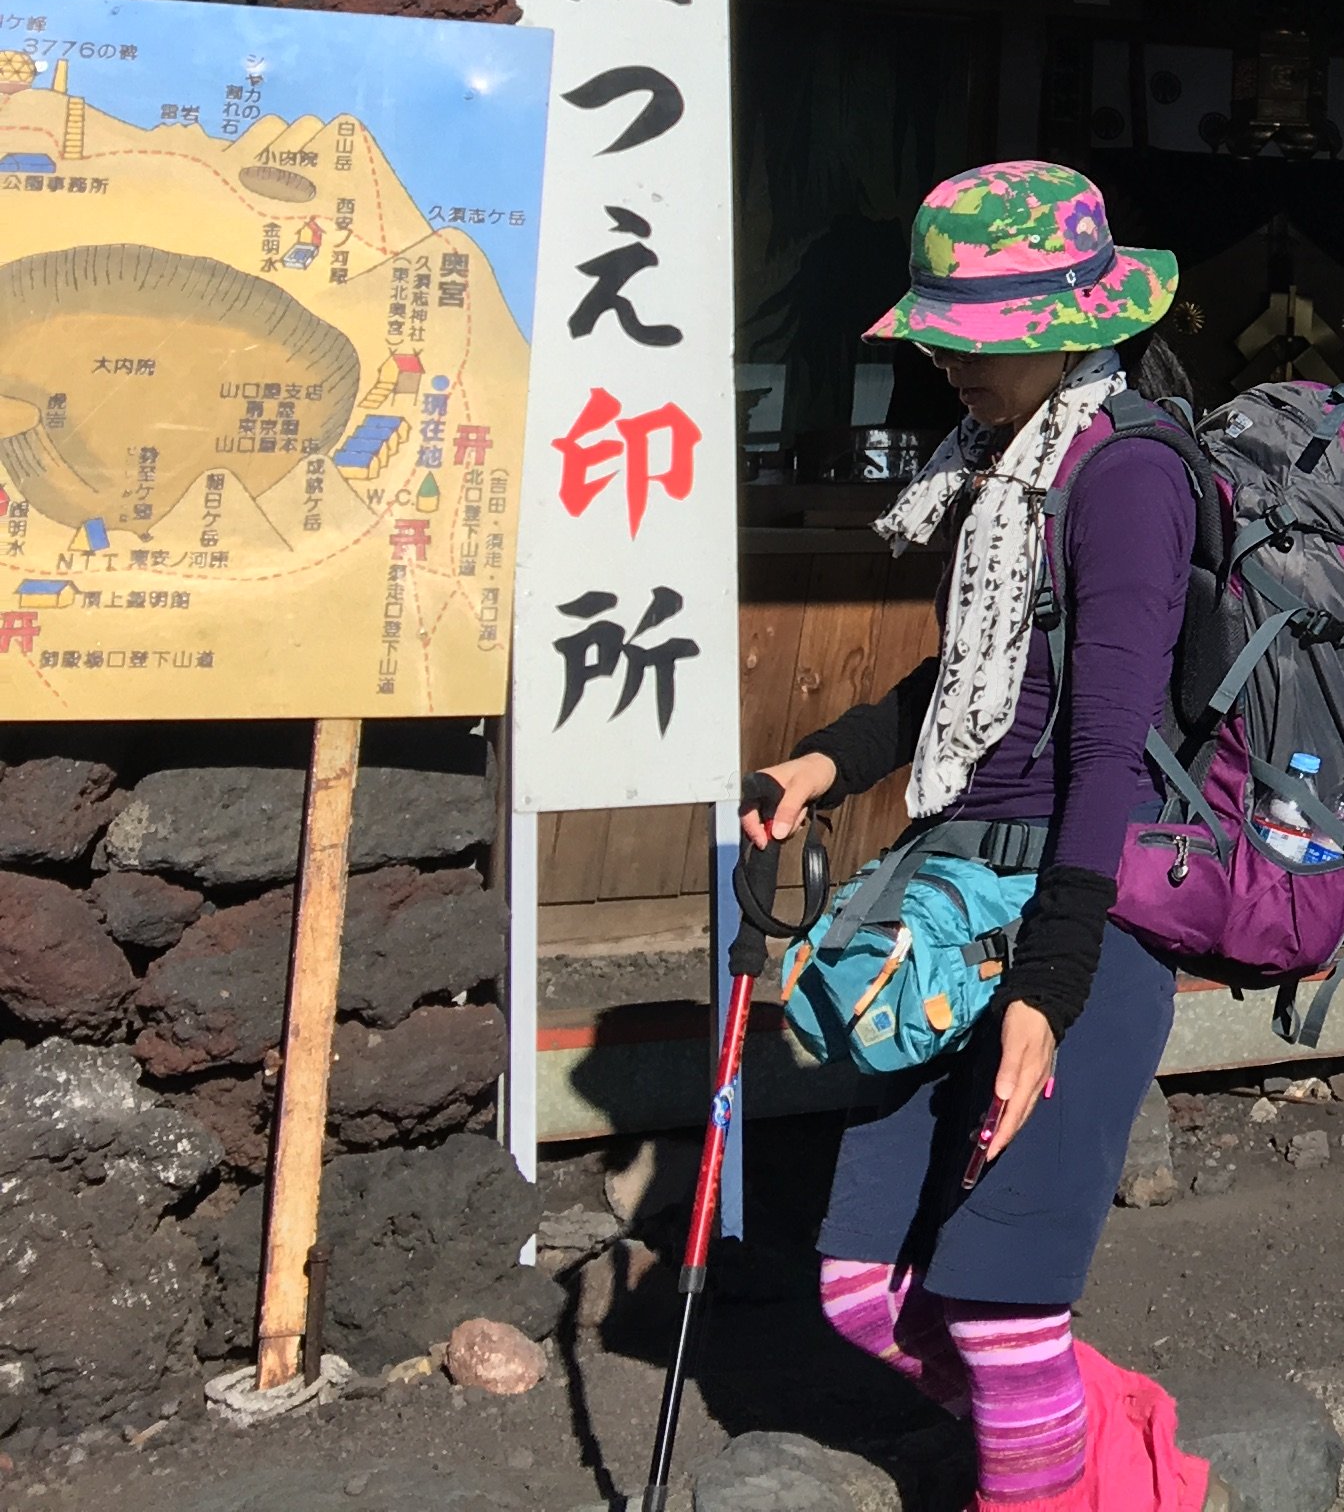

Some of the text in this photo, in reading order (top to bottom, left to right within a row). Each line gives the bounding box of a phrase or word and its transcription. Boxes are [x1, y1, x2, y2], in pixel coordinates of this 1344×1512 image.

[0, 14, 47, 33] ケ峰
[22, 38, 138, 61] 3776の碑
[256, 148, 319, 169] 小内院
[335, 120, 356, 172] 白山岳
[261, 221, 283, 273] 金明水
[407, 255, 433, 343] 久須志神社
[437, 252, 470, 309] 奥宮
[91, 356, 156, 376] 大内院
[219, 382, 323, 401] 山口屋支店
[415, 393, 450, 469] 現在地
[458, 469, 484, 577] 北口登下山道
[375, 564, 407, 695] 須走口登下山道
